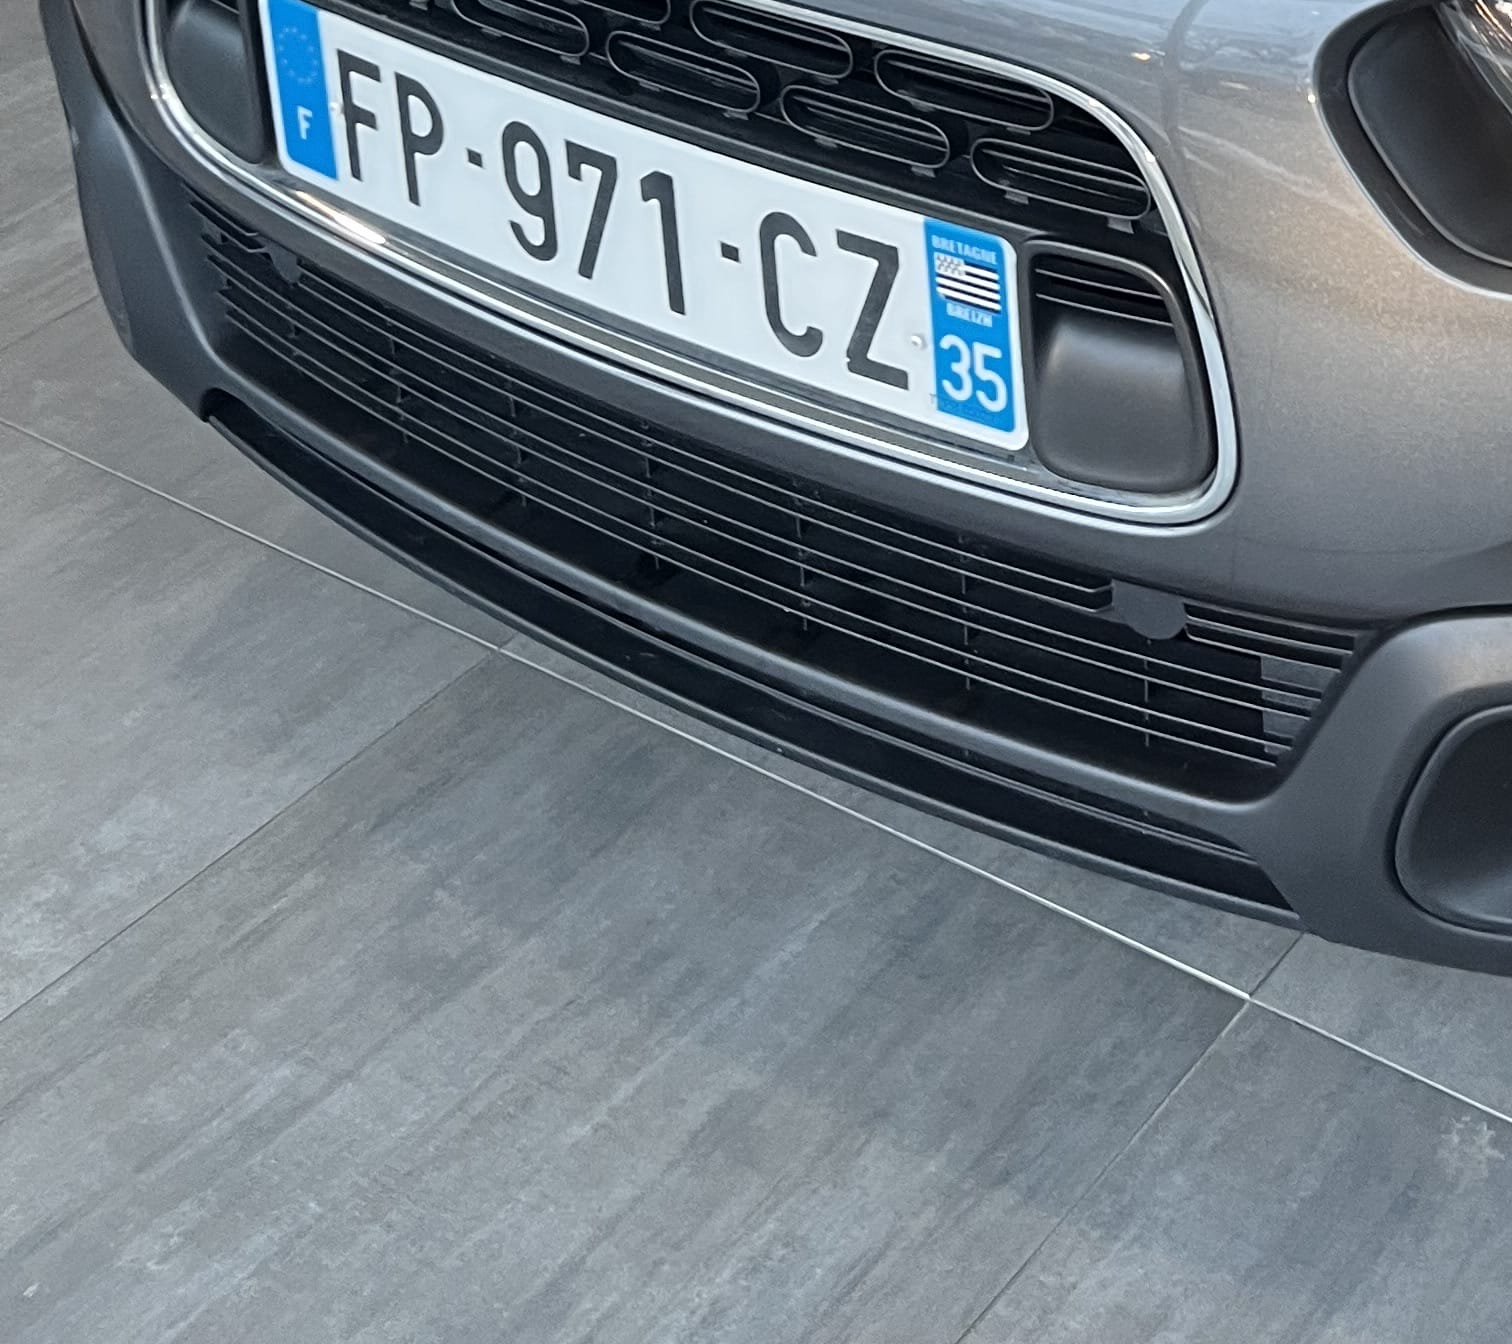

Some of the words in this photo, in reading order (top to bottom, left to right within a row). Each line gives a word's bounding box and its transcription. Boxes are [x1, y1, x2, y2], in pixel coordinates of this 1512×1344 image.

[296, 105, 313, 140] F
[336, 48, 911, 392] FP-971-CZ
[931, 234, 998, 266] BRETAGNE
[946, 301, 993, 328] BREIZH
[939, 333, 1008, 413] 35
